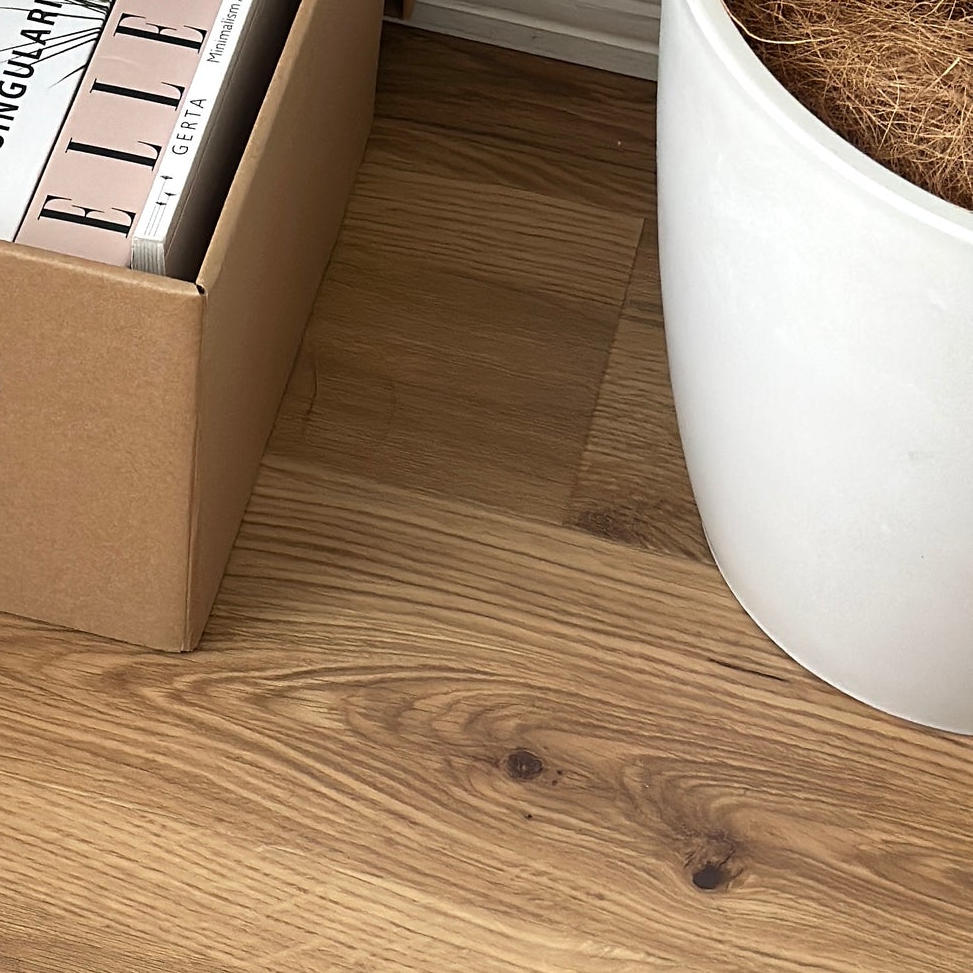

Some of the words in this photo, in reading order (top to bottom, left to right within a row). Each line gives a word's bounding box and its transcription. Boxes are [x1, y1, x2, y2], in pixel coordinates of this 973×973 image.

[37, 13, 207, 238] ELLE
[172, 98, 207, 155] GERTA
[207, 3, 240, 63] Minimalism
